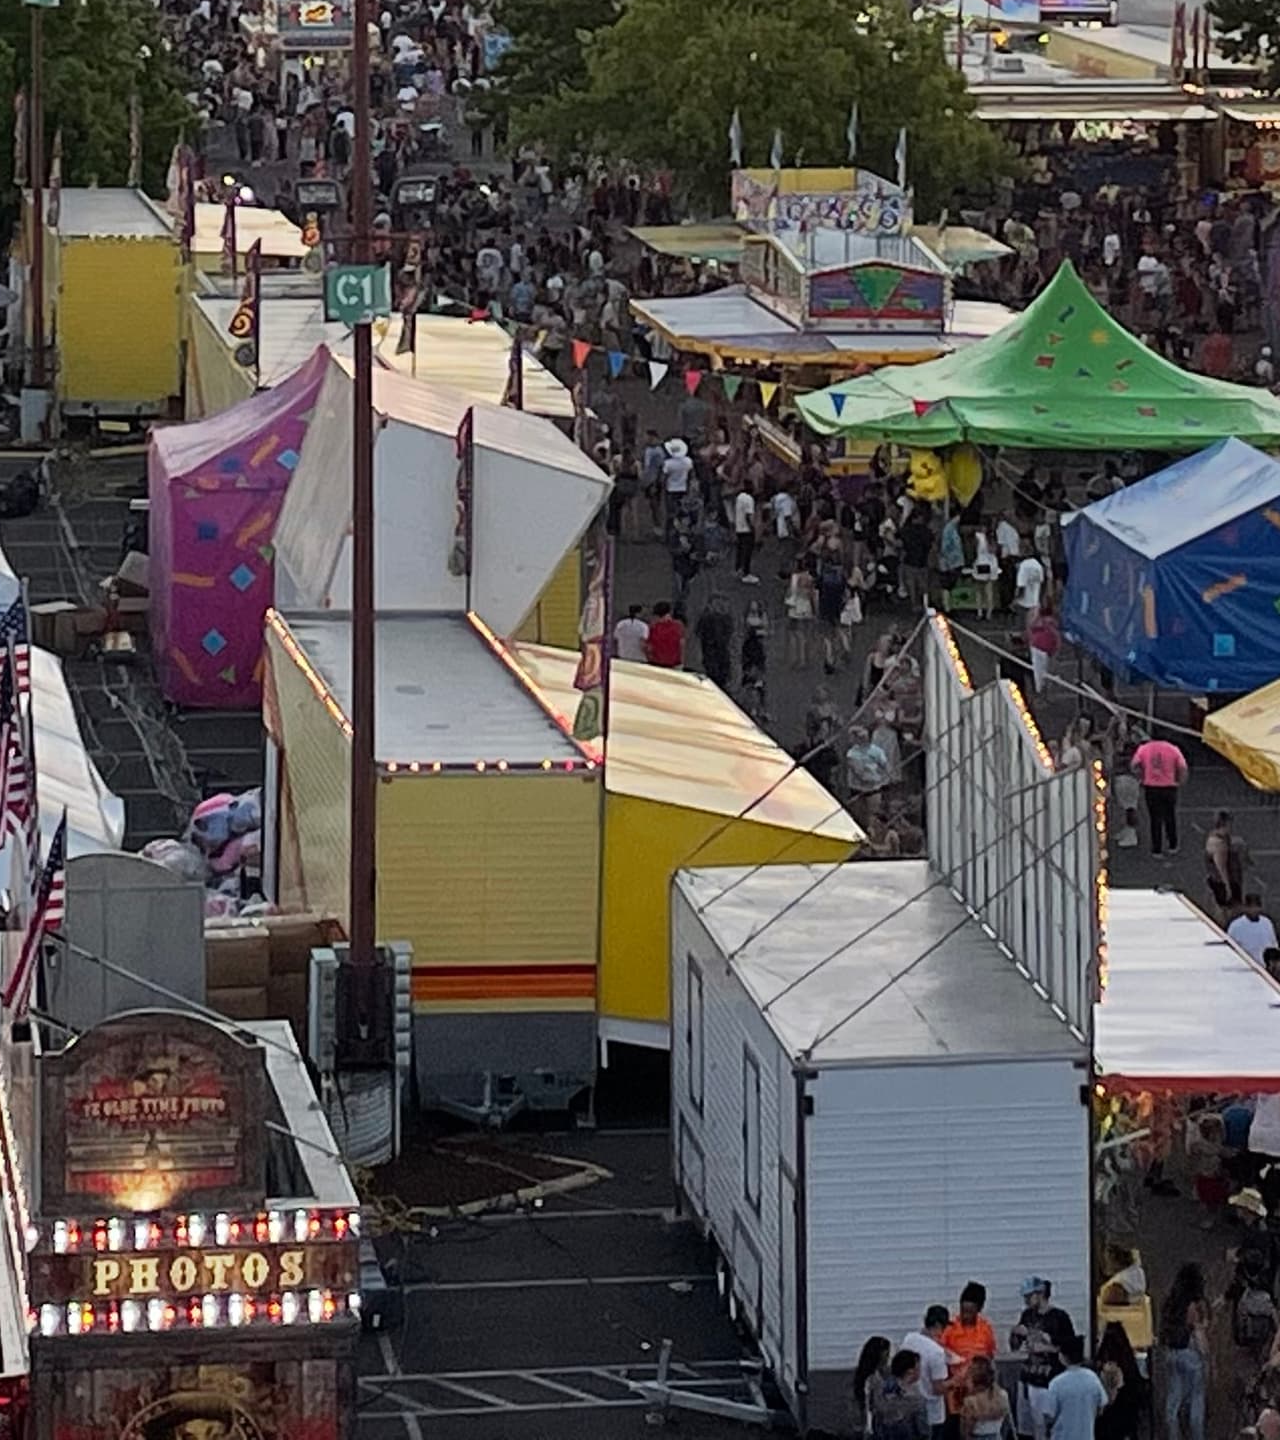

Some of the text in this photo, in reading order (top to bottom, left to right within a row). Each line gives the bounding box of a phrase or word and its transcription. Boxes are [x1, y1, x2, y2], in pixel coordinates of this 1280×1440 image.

[337, 274, 373, 305] C1
[182, 1095, 226, 1114] PHOTO
[92, 1251, 305, 1295] PHOTOS
